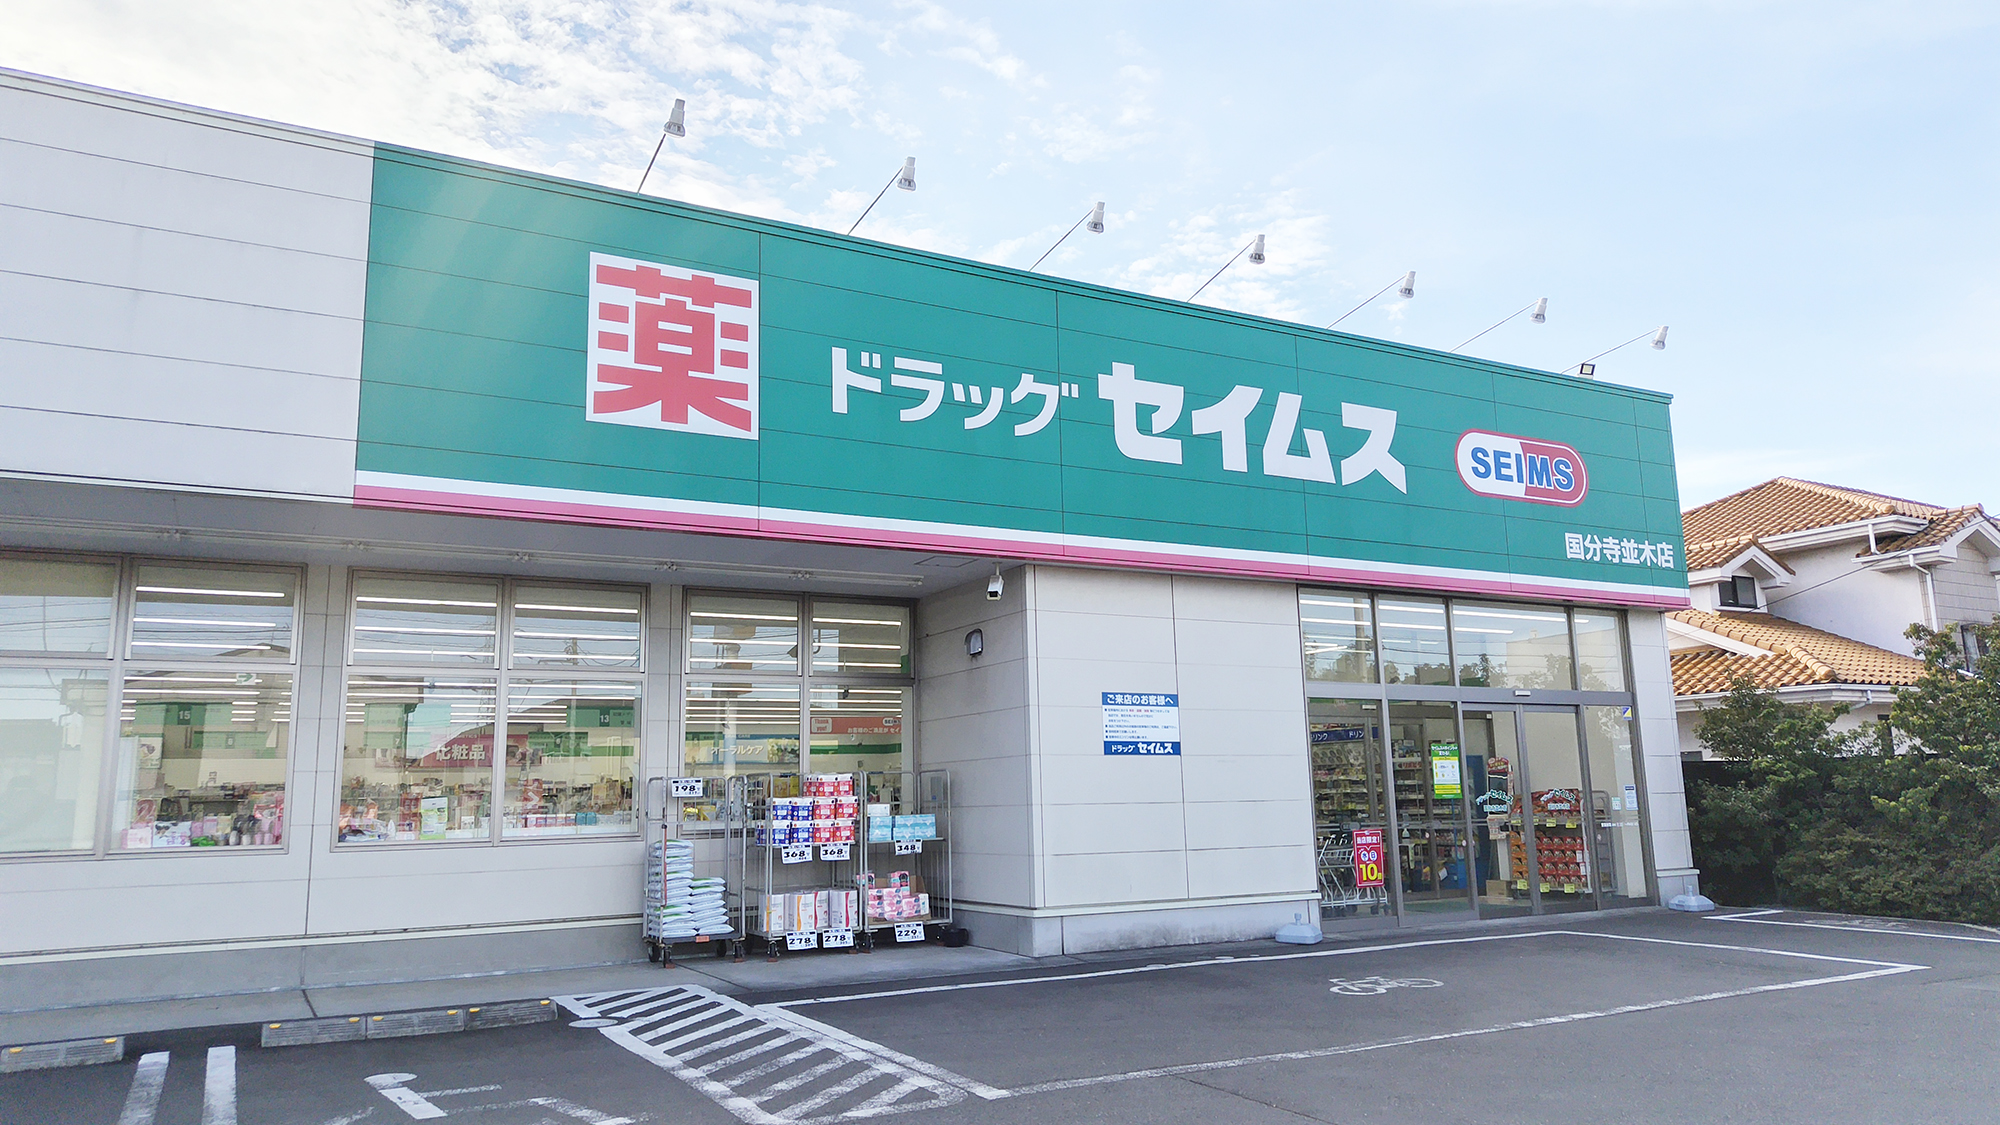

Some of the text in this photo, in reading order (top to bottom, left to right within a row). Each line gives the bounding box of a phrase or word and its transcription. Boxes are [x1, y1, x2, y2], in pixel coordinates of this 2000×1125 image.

[593, 264, 752, 433] 薬
[831, 346, 1408, 496] ドラッグ セイムス
[1470, 445, 1575, 493] SEIMS
[1564, 531, 1675, 570] 国分寺並木店
[1107, 694, 1174, 706] ご来店のお客様へ
[178, 710, 191, 720] 15
[600, 714, 610, 723] 13
[435, 743, 486, 761] 化粧品
[710, 745, 764, 756] オーラルケア
[1111, 742, 1174, 754] ドラッグ セイムス
[822, 848, 843, 856] 368
[897, 844, 916, 852] 348
[783, 850, 806, 858] 368
[1359, 863, 1378, 881] 10
[897, 928, 918, 937] 229
[788, 936, 812, 945] 278
[824, 934, 846, 943] 278
